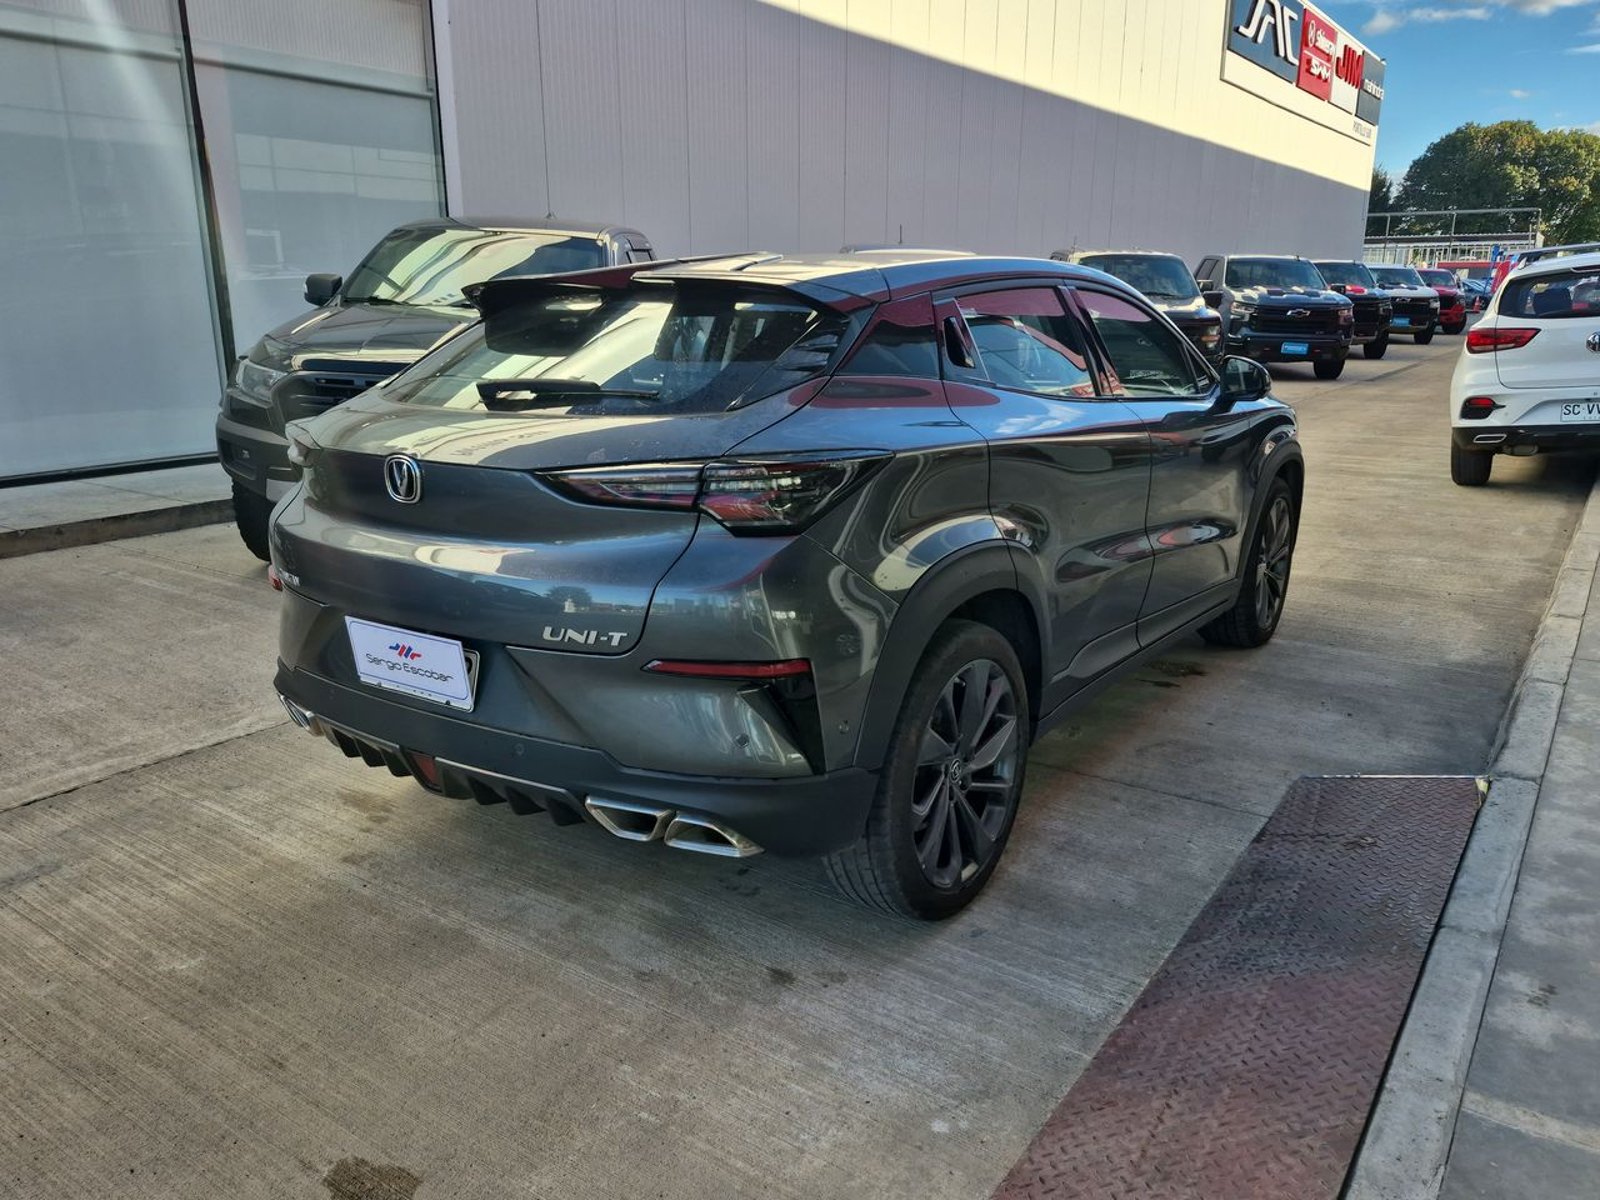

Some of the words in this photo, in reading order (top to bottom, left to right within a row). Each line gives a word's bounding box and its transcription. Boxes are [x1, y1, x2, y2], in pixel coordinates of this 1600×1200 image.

[1238, 0, 1299, 66] JAC
[542, 626, 628, 646] UNI-T
[402, 662, 454, 682] Escobar
